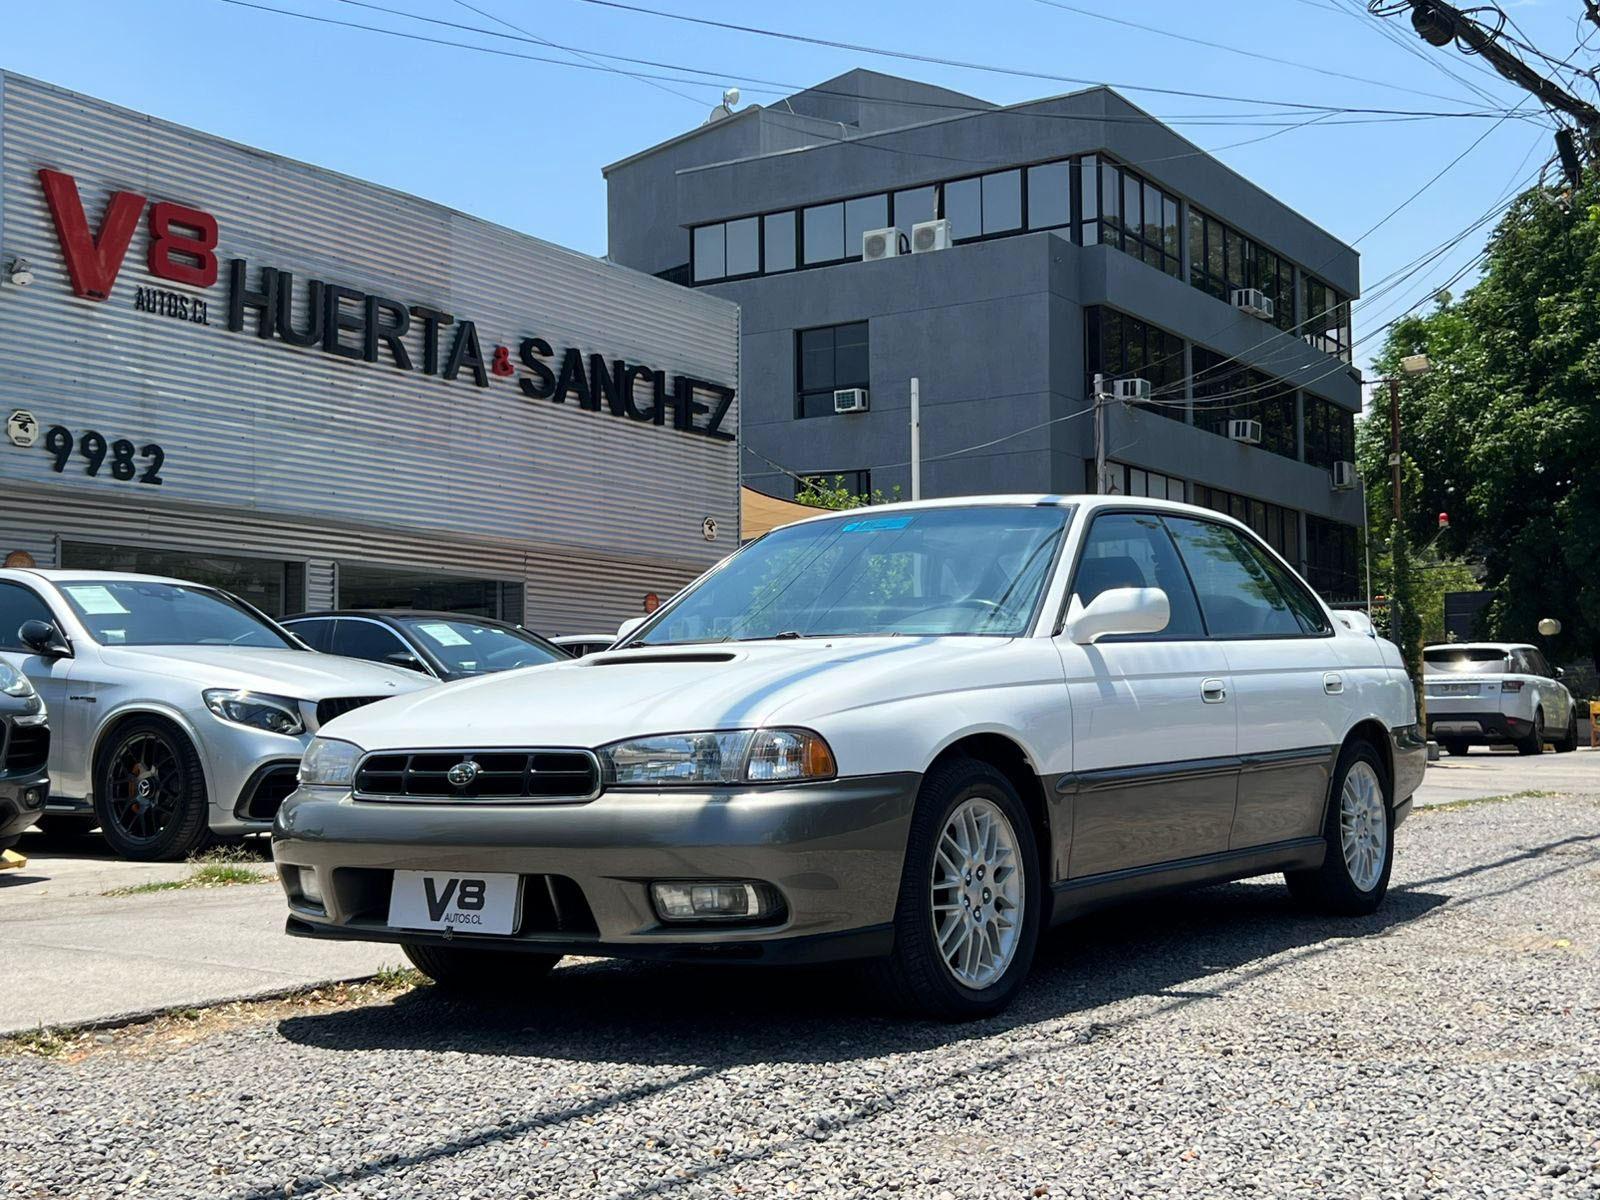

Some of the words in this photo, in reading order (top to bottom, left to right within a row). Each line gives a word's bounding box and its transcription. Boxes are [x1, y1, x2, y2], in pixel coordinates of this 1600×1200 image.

[38, 168, 218, 301] V8
[135, 286, 210, 325] AUTOS.CL
[228, 258, 489, 388] HUERTA
[491, 346, 514, 376] &
[518, 337, 735, 441] SANCHEZ
[46, 424, 165, 485] 9982
[423, 877, 487, 922] V8
[443, 912, 483, 925] AUTOS.CL
